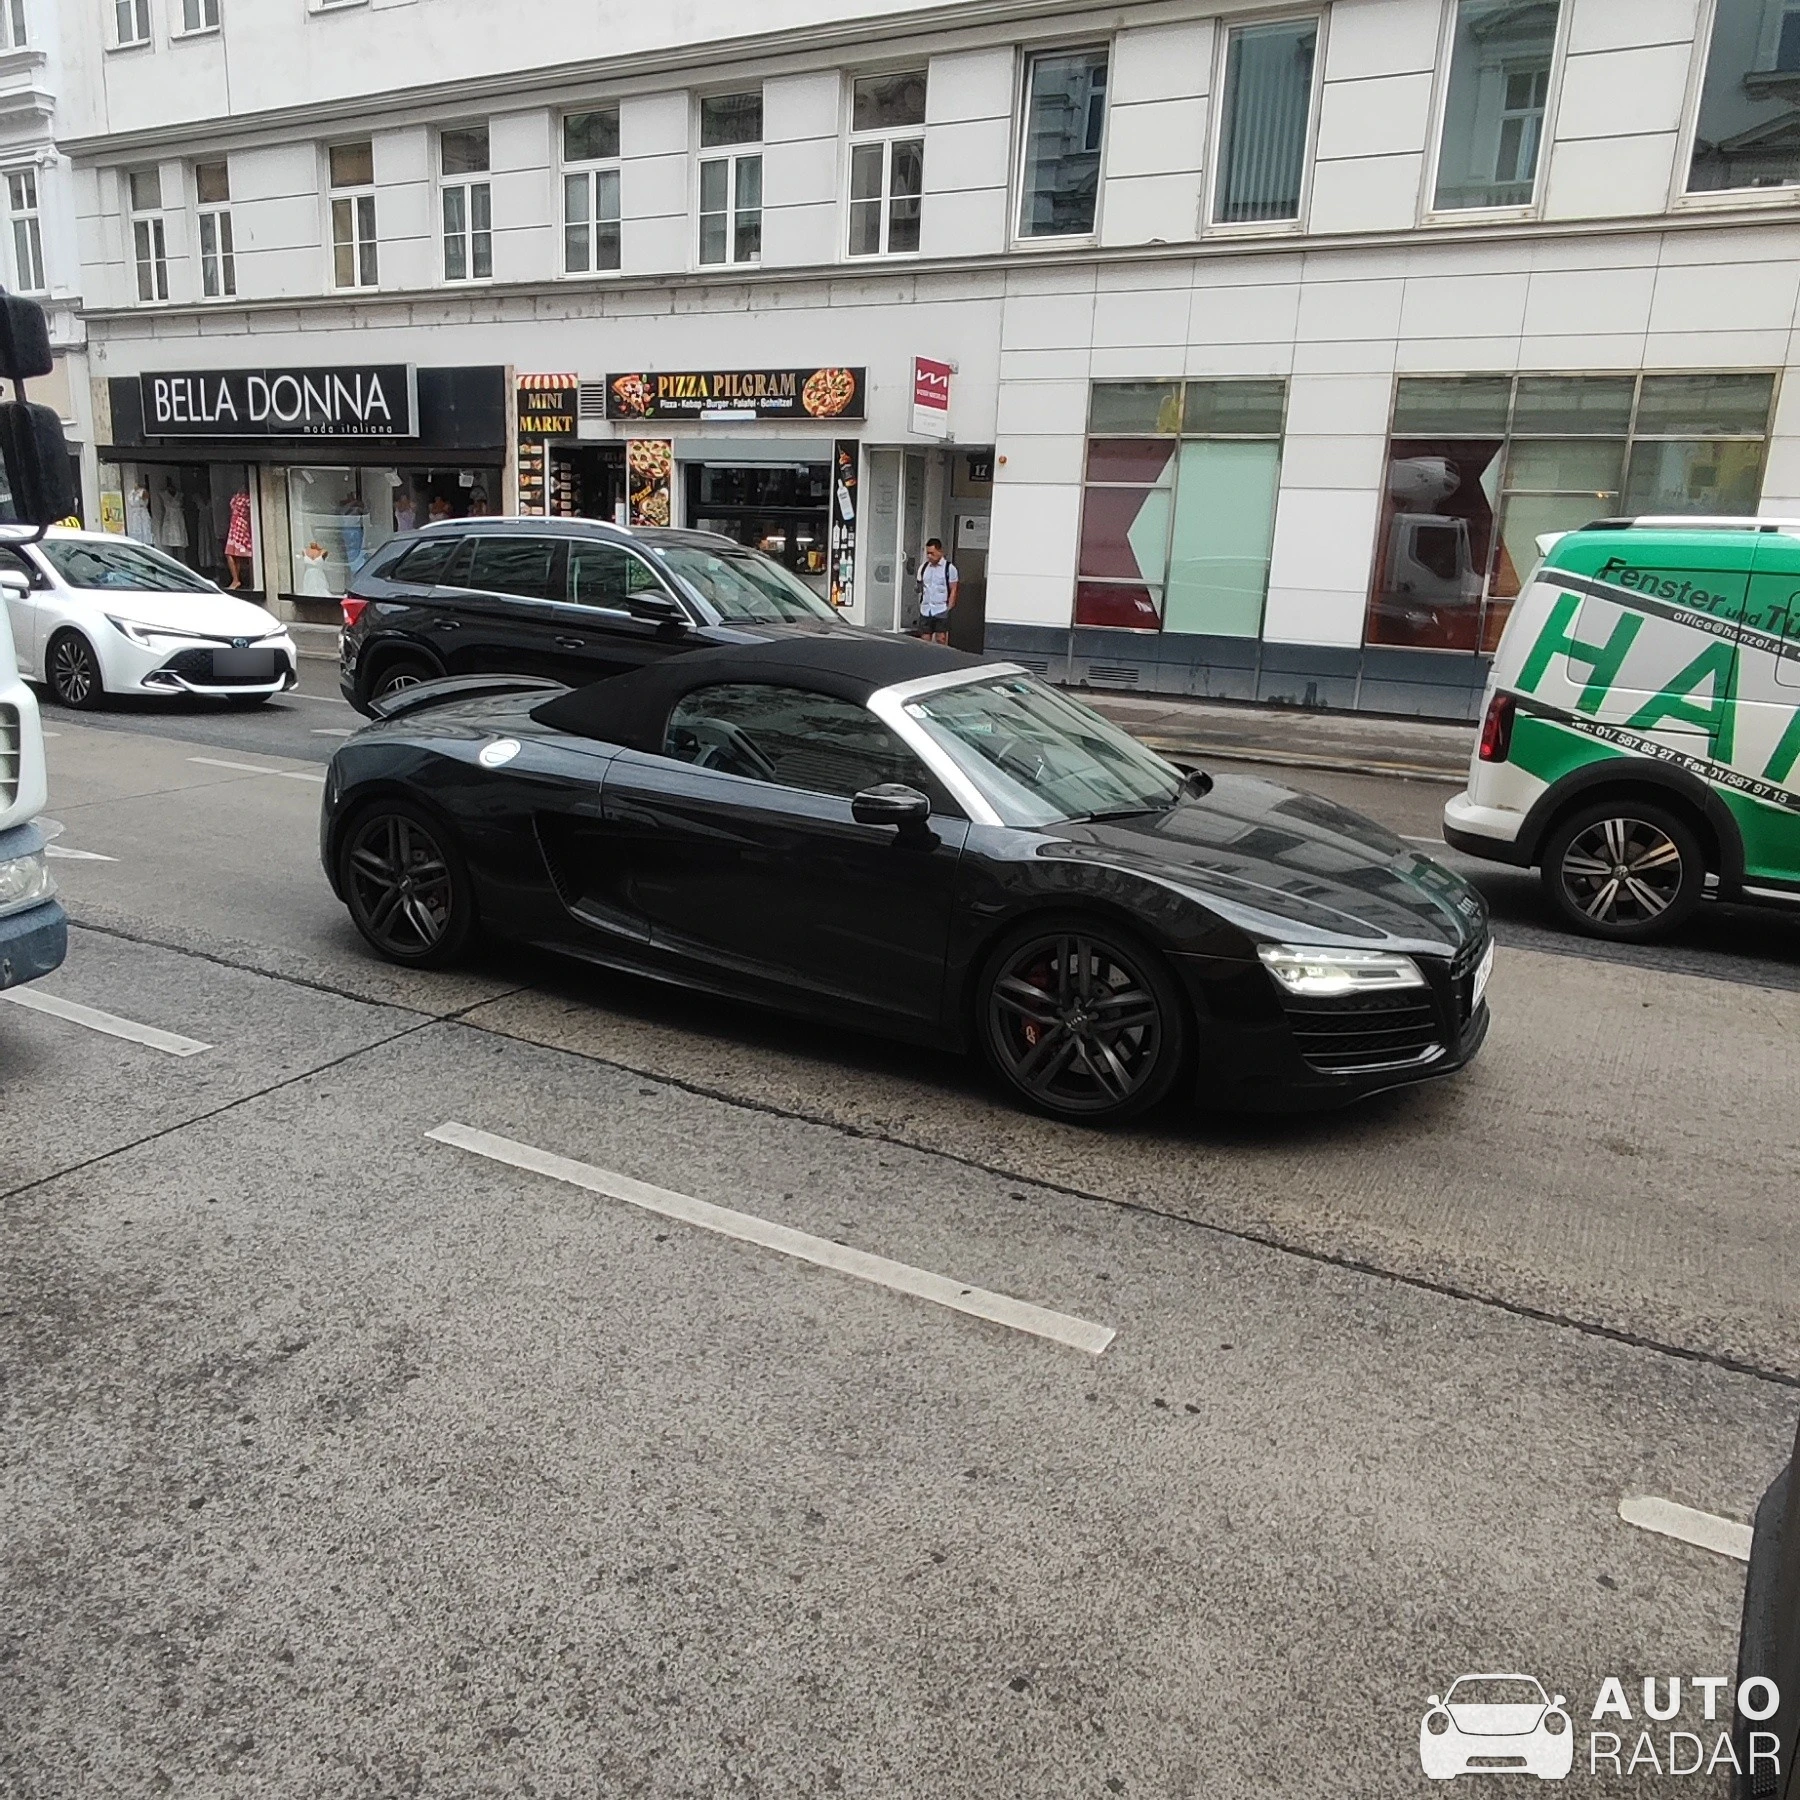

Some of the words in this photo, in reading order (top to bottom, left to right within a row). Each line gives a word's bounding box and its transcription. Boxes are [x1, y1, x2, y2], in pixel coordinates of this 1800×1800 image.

[657, 375, 709, 398] PIZZA
[713, 372, 796, 397] PILGRAM
[154, 376, 239, 422] BELLA
[247, 373, 392, 422] DONNA
[528, 392, 563, 410] MINI
[660, 399, 678, 409] Pizza
[706, 398, 730, 410] Burger
[760, 397, 793, 408] Schnitzel
[303, 421, 334, 434] moda
[340, 420, 393, 434] italiana
[519, 415, 574, 432] MARKT
[975, 464, 988, 477] 17
[1600, 556, 1727, 613] Fenster
[1725, 607, 1763, 626] und
[1673, 611, 1788, 656] office@hanzel.at
[1616, 733, 1641, 748] 587
[1657, 748, 1676, 761] 27
[1683, 757, 1707, 774] Fax
[1752, 783, 1771, 797] 97
[1773, 790, 1789, 803] 15
